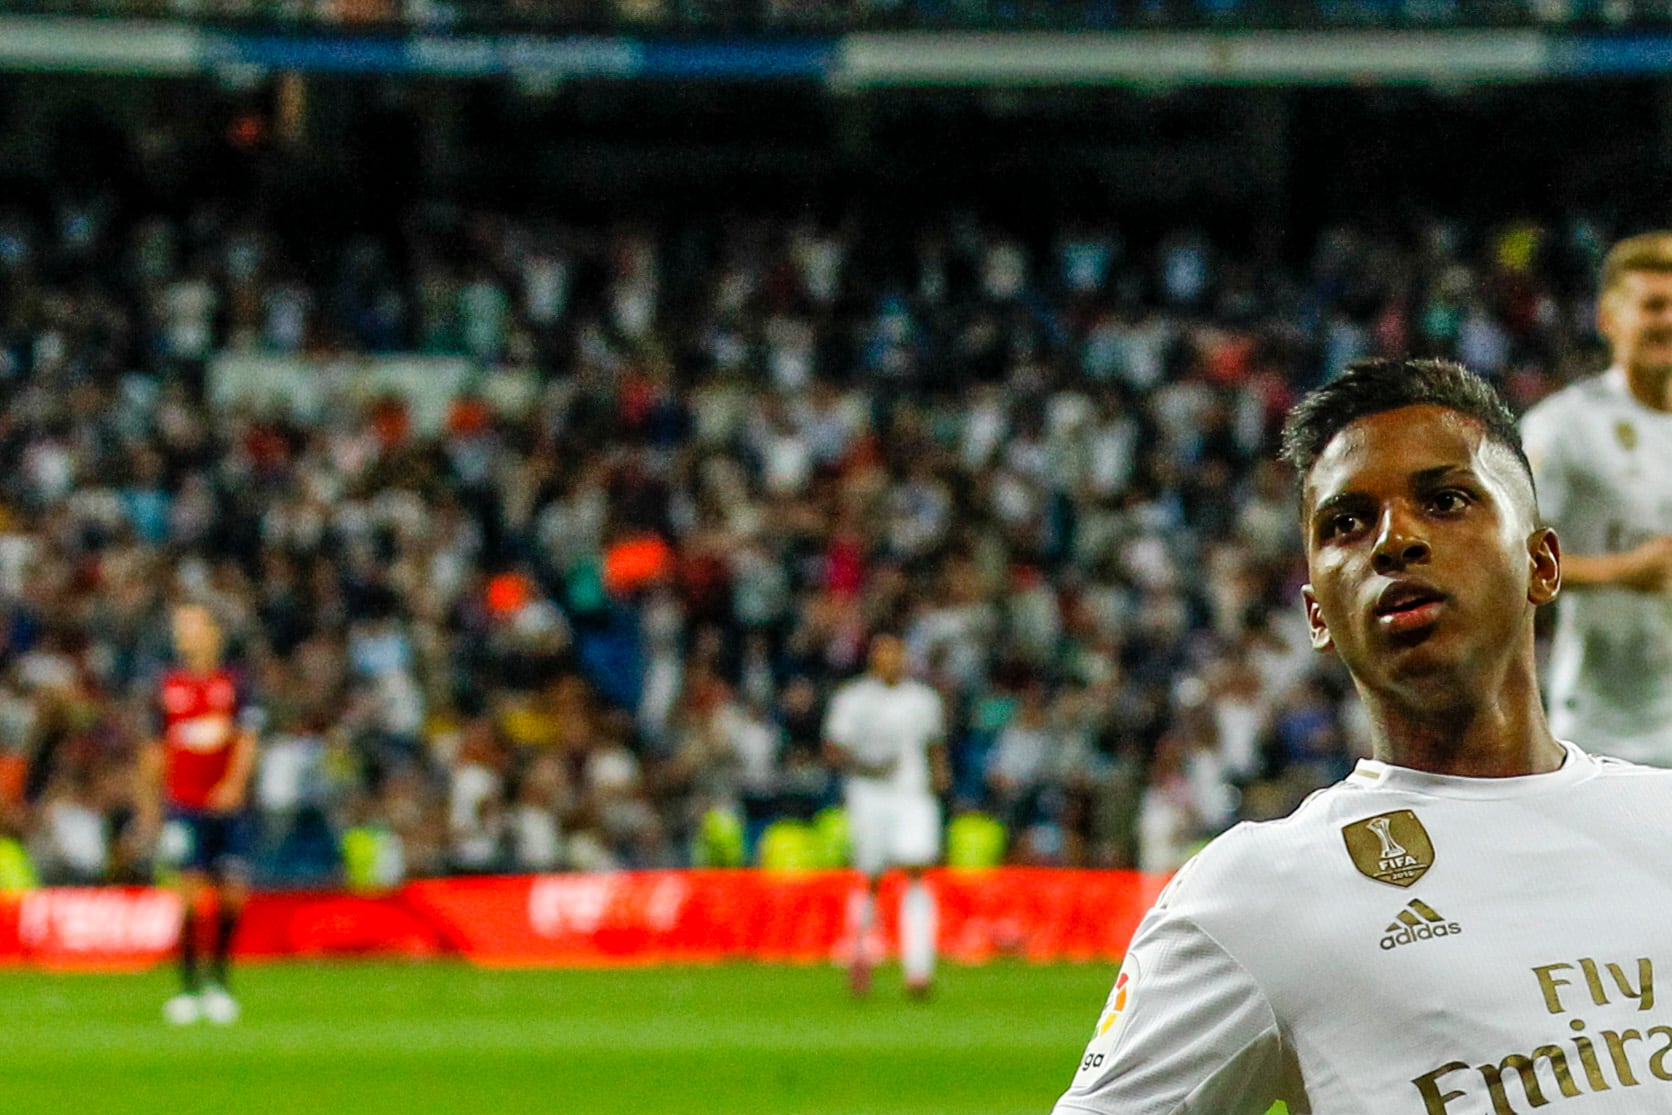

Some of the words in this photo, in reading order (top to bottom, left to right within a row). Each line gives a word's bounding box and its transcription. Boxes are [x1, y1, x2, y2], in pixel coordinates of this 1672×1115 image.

[1378, 855, 1417, 871] FIFA
[1380, 922, 1462, 950] adidas
[1531, 957, 1654, 1014] Fly
[1082, 1053, 1105, 1071] ga
